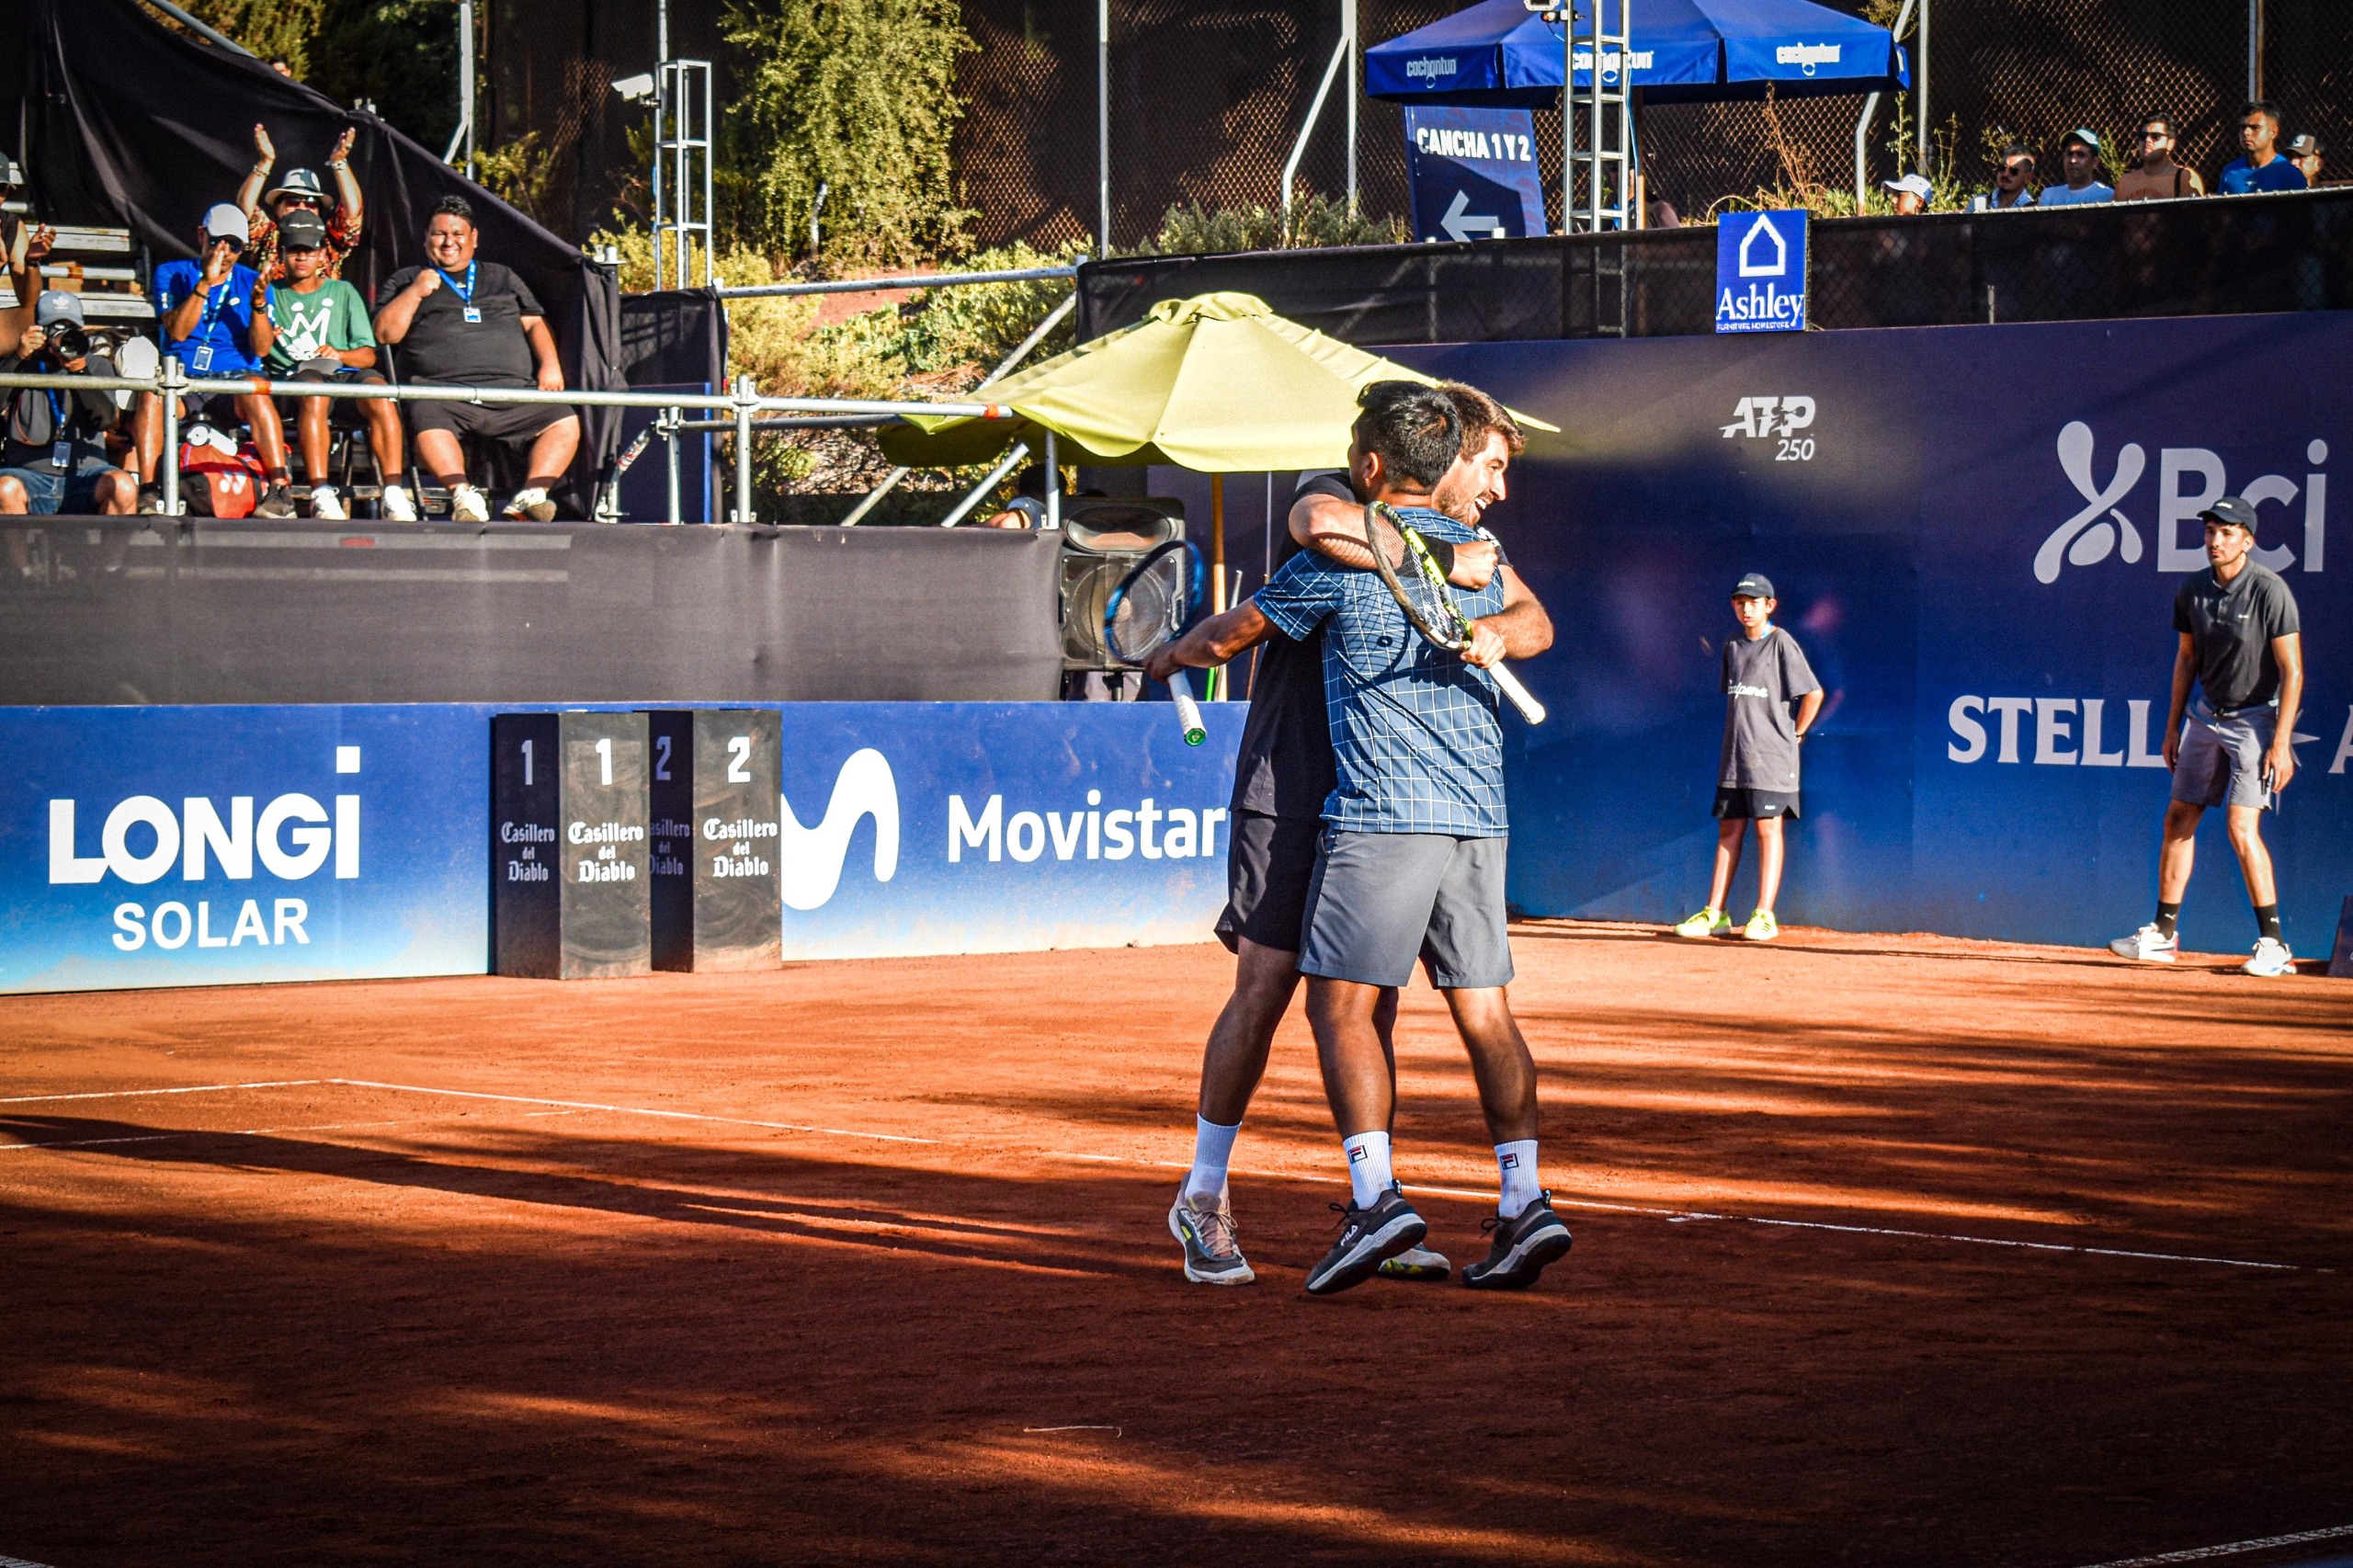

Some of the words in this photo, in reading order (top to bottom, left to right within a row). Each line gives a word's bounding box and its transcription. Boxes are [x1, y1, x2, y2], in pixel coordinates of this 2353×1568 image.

[1416, 128, 1490, 159] CANCHA
[1491, 131, 1503, 160] 1
[1503, 134, 1517, 161] Y
[1518, 134, 1532, 162] 2
[1715, 282, 1804, 327] Ashley
[1719, 395, 1816, 438] ATP
[1775, 438, 1815, 460] 250
[2156, 438, 2328, 574] Bci
[1948, 695, 2189, 767] STELL
[521, 739, 533, 786] 1
[595, 738, 613, 786] 1
[655, 736, 672, 781] 2
[727, 736, 751, 783] 2
[501, 821, 555, 844] Casillero
[567, 821, 644, 846] Casillero
[650, 818, 690, 837] asillero
[702, 817, 779, 841] Casillero
[948, 789, 1227, 863] Movistar
[522, 846, 535, 860] del
[598, 845, 617, 860] del
[733, 841, 750, 856] del
[507, 860, 550, 882] Diablo
[578, 860, 636, 883] Diablo
[712, 855, 769, 879] Diablo
[112, 898, 311, 951] SOLAR
[1340, 1224, 1358, 1247] FILA
